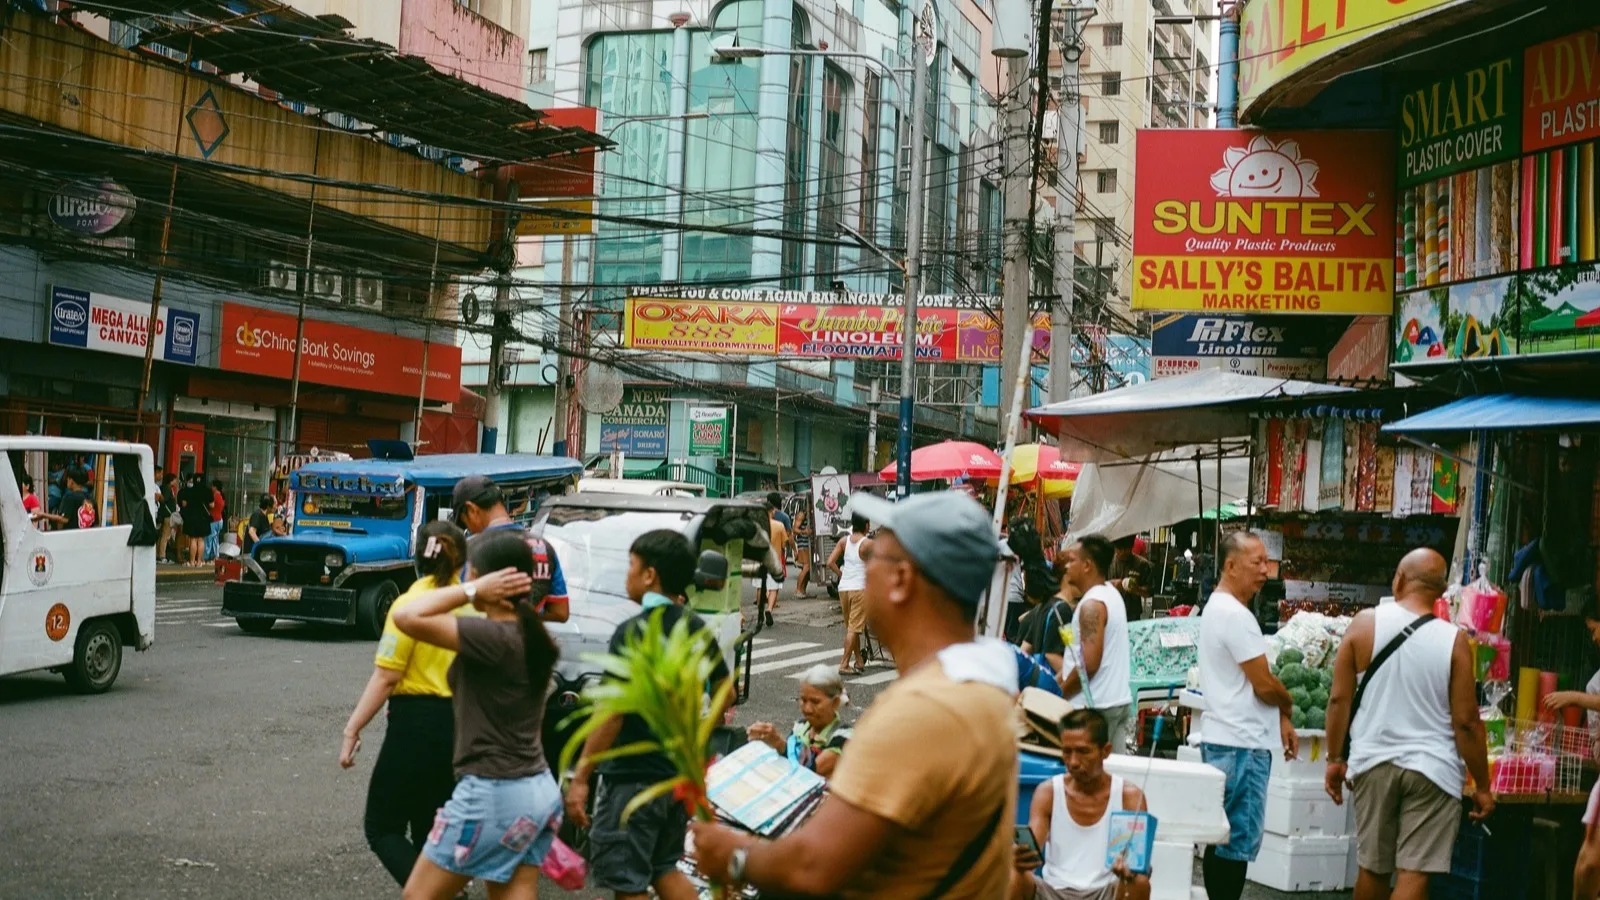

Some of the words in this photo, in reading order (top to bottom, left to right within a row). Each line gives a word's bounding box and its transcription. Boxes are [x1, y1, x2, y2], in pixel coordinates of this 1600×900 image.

[1529, 29, 1600, 108] ADV
[1402, 58, 1512, 148] SMART
[1406, 138, 1452, 178] PLASTIC
[1456, 124, 1503, 162] COVER
[1153, 201, 1376, 236] SUNTEX
[1185, 237, 1231, 253] Quality
[1234, 238, 1276, 251] Plastic
[1279, 239, 1336, 252] Products
[1139, 259, 1263, 291] SALLY'S
[1273, 261, 1387, 293] BALITA
[680, 287, 706, 298] YOU
[709, 288, 718, 299] &
[722, 289, 762, 300] COME
[765, 290, 808, 302] AGAIN
[811, 291, 884, 305] BARANGAY
[887, 294, 905, 305] 26
[917, 295, 953, 307] ZONE
[1202, 293, 1321, 310] MARKETING
[91, 307, 123, 329] MEGA
[127, 314, 164, 335] ALLID
[636, 303, 775, 326] OSAKA
[799, 306, 879, 332] Jumbo
[880, 308, 943, 333] Pltic
[100, 327, 147, 347] CANVAS
[635, 338, 659, 346] HIGH
[700, 341, 774, 350] FLOORMATTING
[301, 337, 329, 358] Bank
[332, 343, 375, 369] Savings
[802, 343, 941, 357] FLOORMATNG
[1197, 343, 1278, 355] Linoleum
[632, 390, 666, 403] NEW
[601, 416, 666, 425] COMMERCIAL
[693, 431, 722, 440] LUNA
